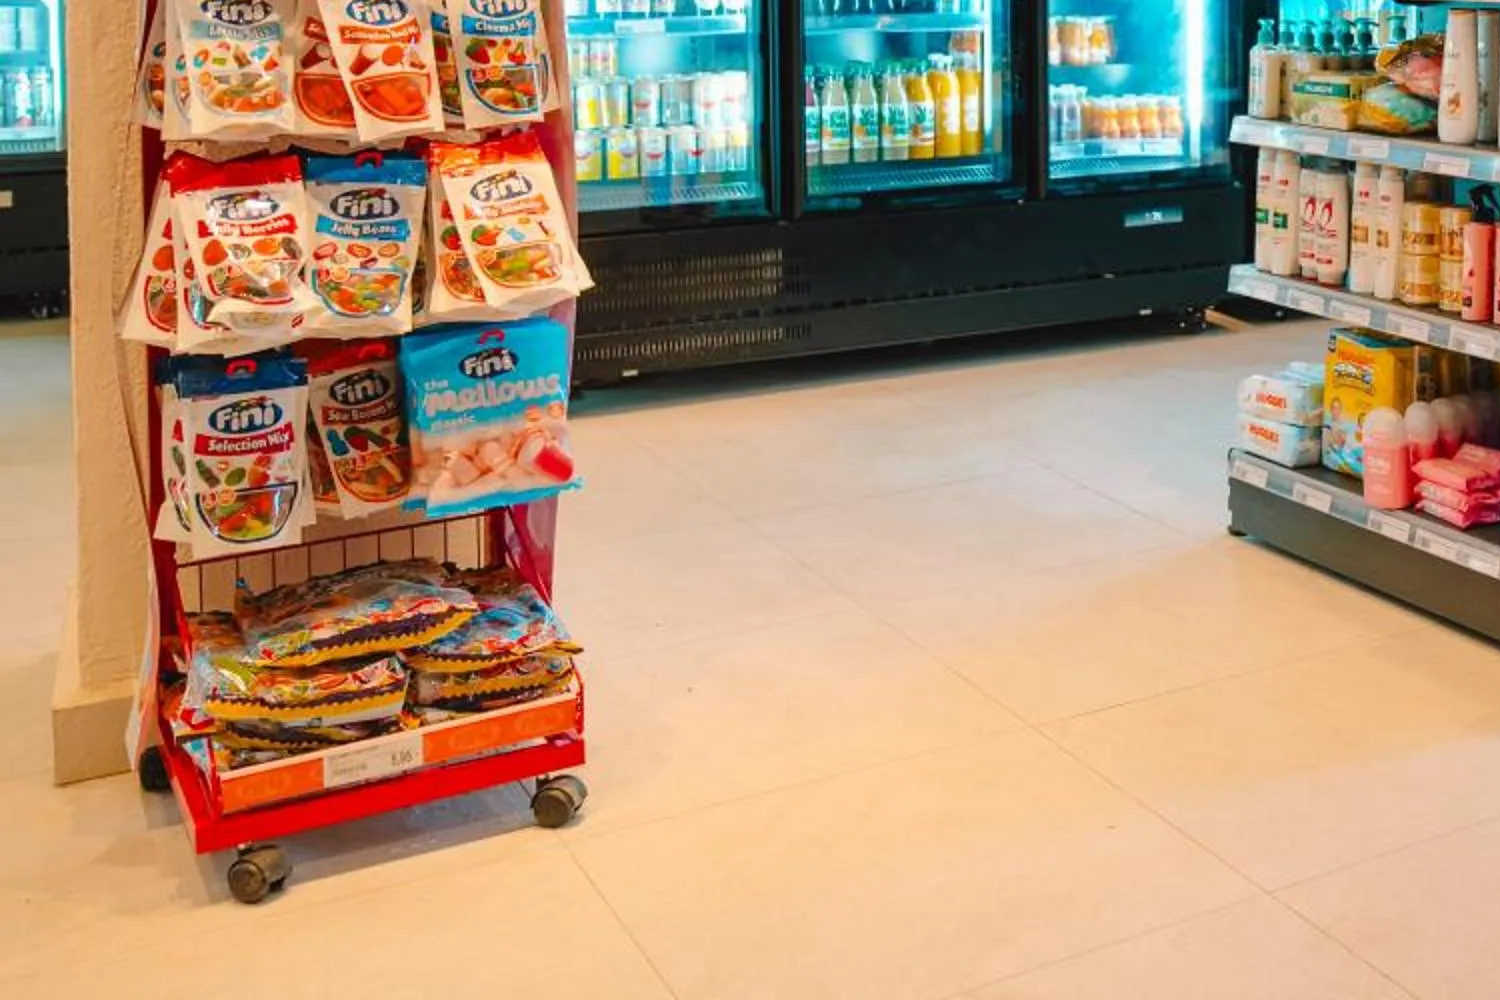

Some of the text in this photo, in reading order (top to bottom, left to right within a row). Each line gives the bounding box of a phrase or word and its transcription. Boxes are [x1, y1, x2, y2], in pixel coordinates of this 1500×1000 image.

[475, 174, 529, 199] Fini
[336, 194, 394, 219] Fini
[464, 349, 515, 377] Fini
[334, 374, 384, 402] Fini
[215, 398, 276, 431] Fini
[207, 437, 267, 451] Selection
